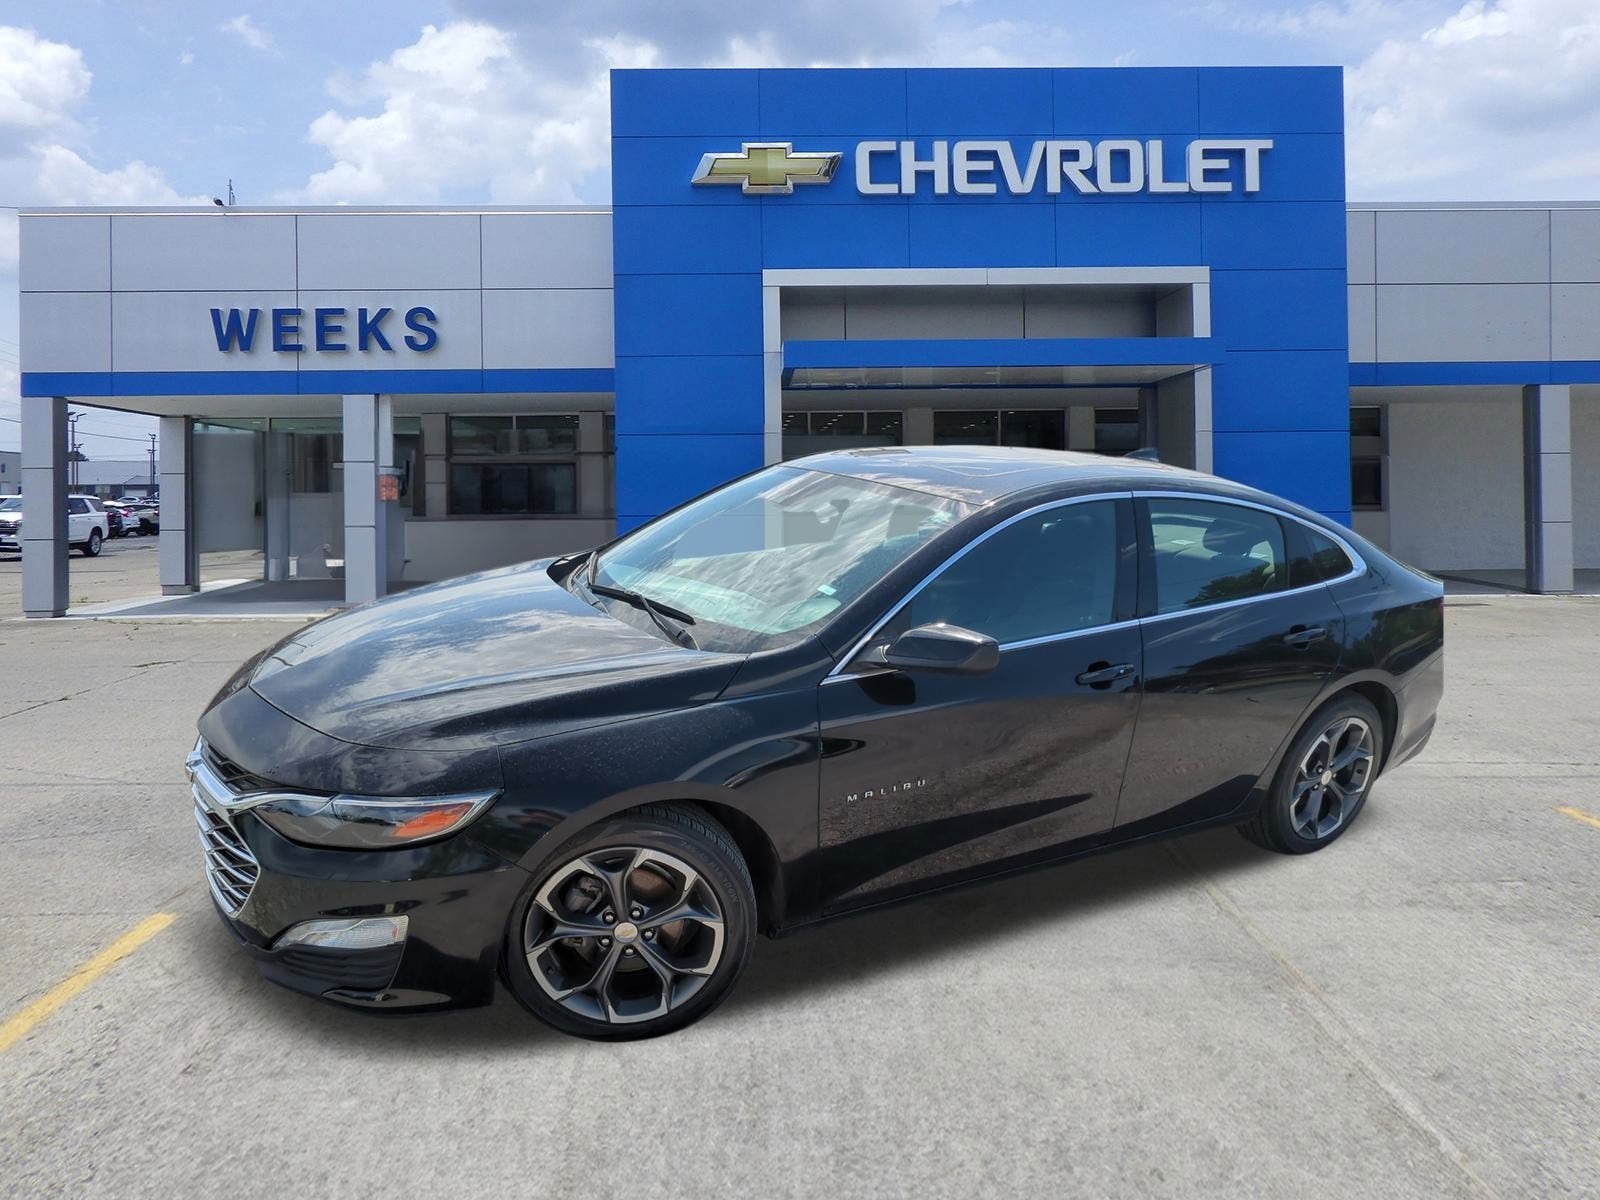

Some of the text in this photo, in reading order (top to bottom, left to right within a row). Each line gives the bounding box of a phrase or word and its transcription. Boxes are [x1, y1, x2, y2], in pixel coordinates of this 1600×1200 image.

[855, 139, 1274, 195] CHEVROLET
[210, 306, 438, 354] WEEKS
[847, 779, 926, 802] MALIBU
